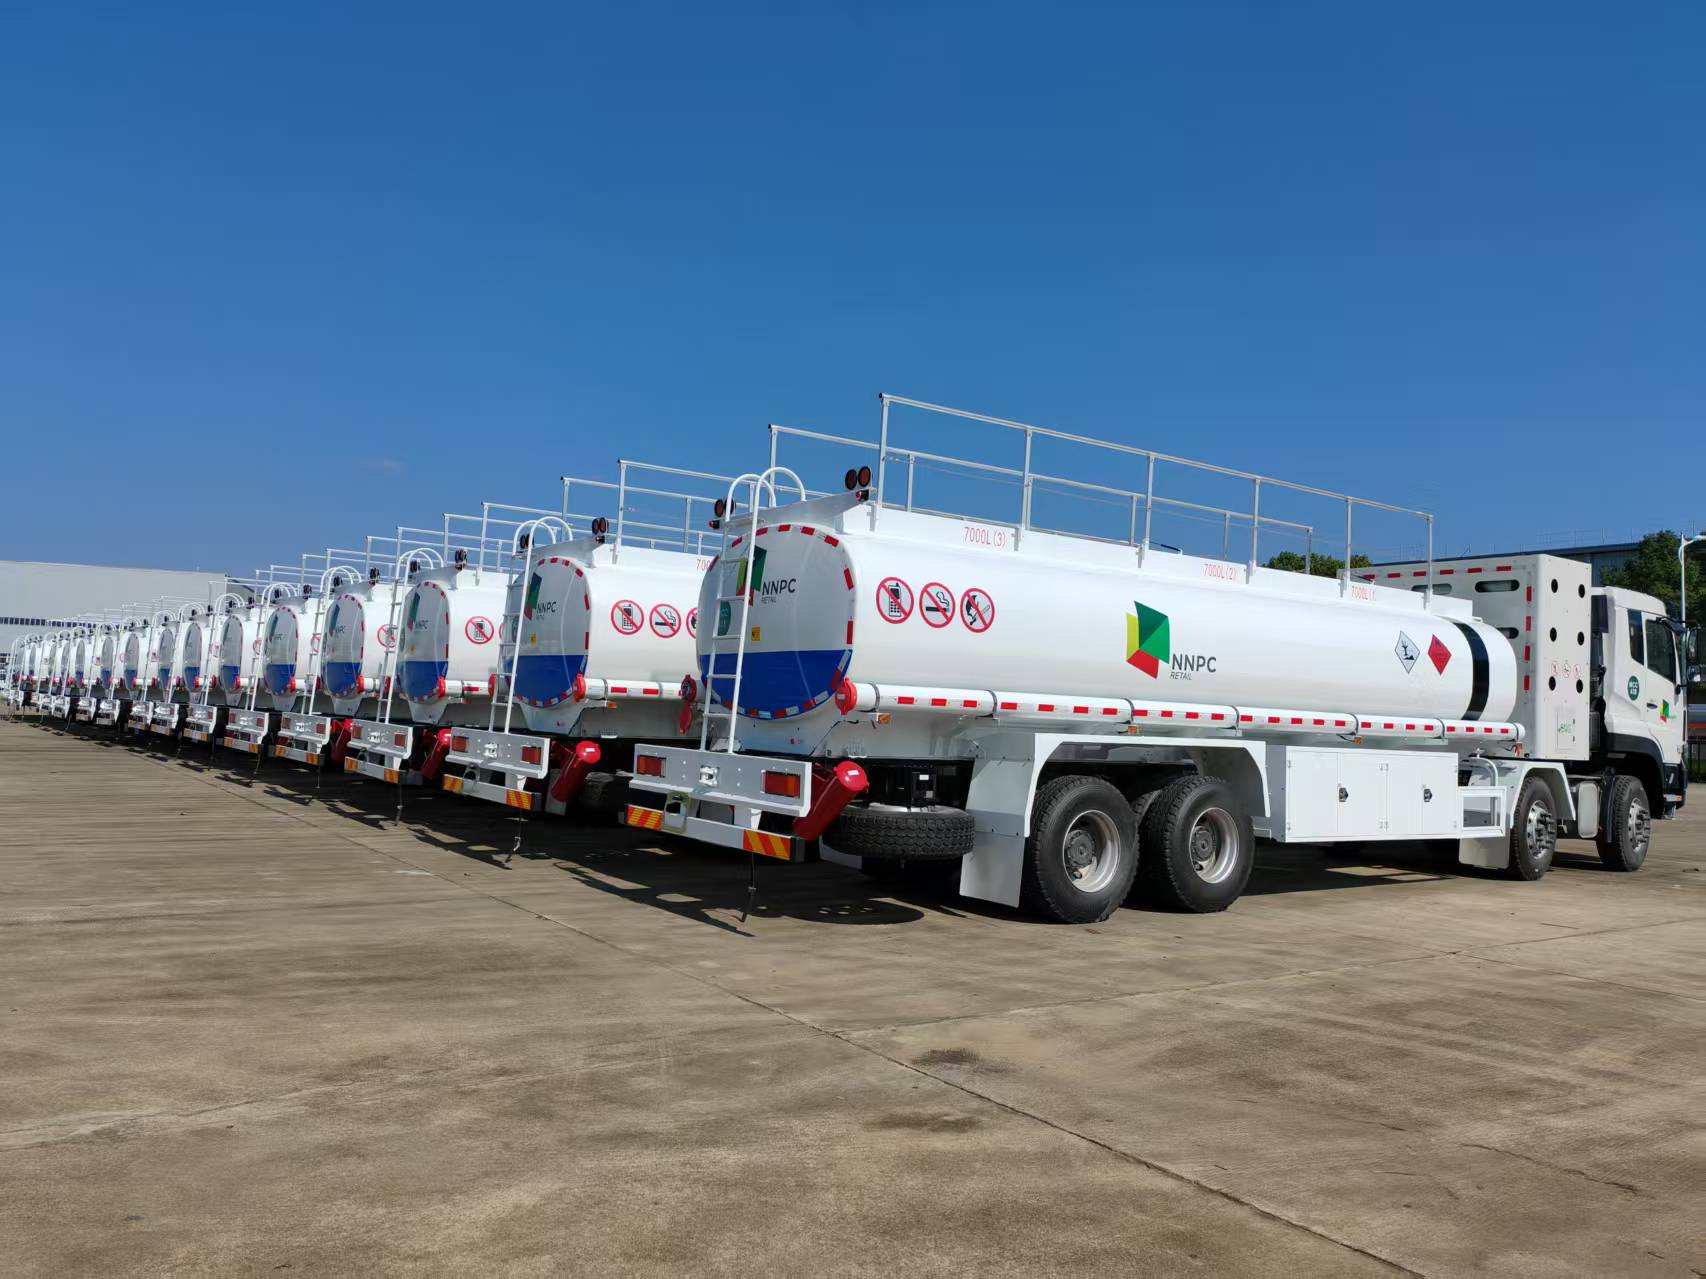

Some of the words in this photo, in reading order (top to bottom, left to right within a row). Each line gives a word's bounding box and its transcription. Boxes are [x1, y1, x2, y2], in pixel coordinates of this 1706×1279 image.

[762, 578, 797, 596] NNPC
[536, 601, 557, 614] NNPC
[1172, 653, 1217, 673] NNPC
[1170, 671, 1192, 681] RETAIL
